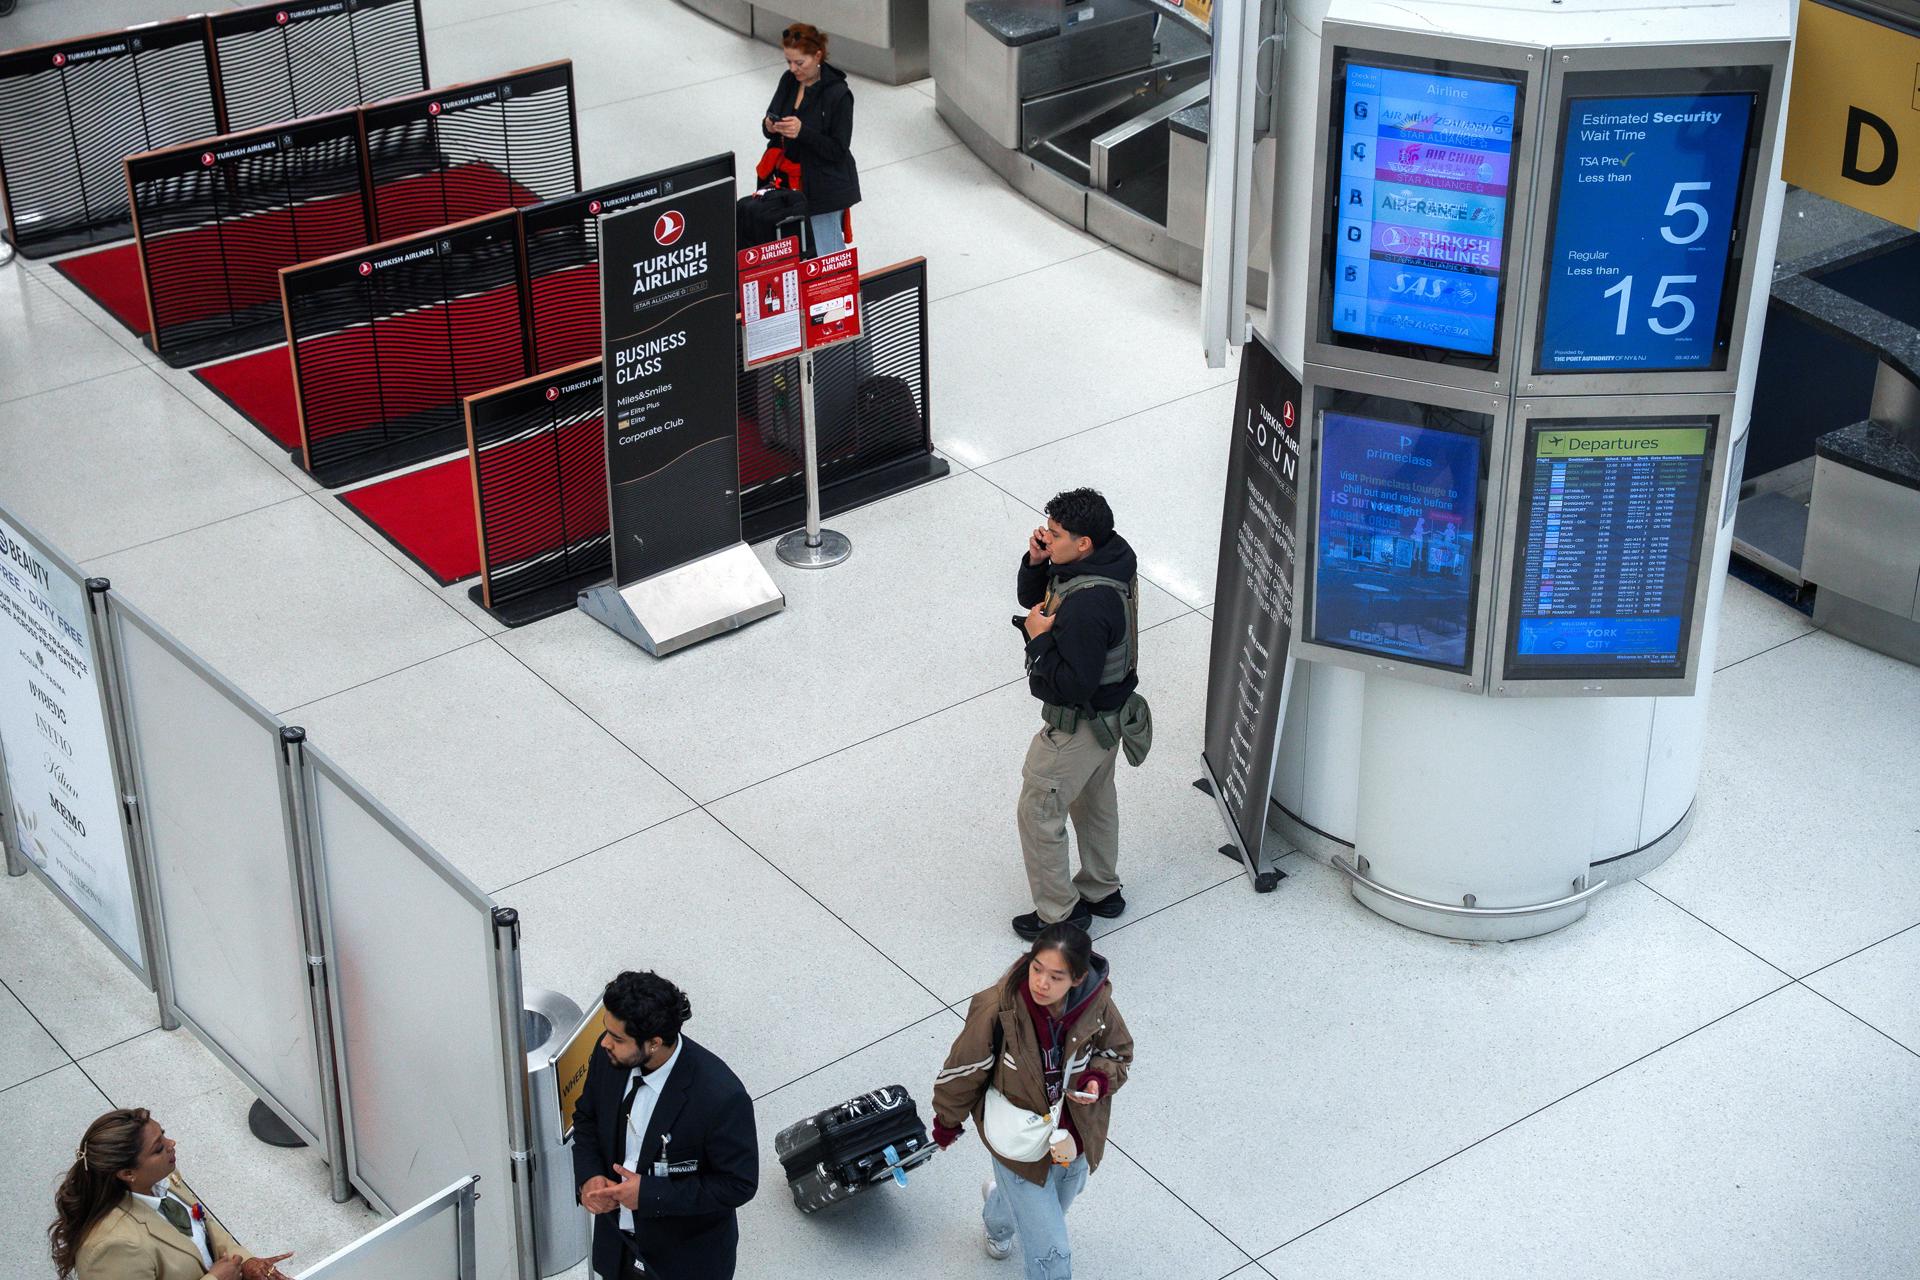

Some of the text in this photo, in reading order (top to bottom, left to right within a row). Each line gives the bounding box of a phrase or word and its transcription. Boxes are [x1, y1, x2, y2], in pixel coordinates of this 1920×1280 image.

[290, 2, 343, 19] TURKISH AIRLINES
[67, 44, 126, 61] TURKISH AIRLINES
[442, 91, 497, 110] TURKISH AIRLINES
[1427, 84, 1469, 98] Airline
[1582, 110, 1722, 126] Estimated Security
[1400, 131, 1477, 148] STAR ALLIANCE
[1581, 129, 1646, 142] Wait Time
[1841, 105, 1898, 186] D
[216, 141, 276, 162] TURKISH AIRLINES
[1426, 148, 1485, 166] AIR CHINA
[1580, 156, 1619, 166] TSA Pre
[1396, 174, 1421, 184] STAR
[1424, 178, 1473, 192] ALLIANCE
[1578, 172, 1632, 183] Less than
[602, 188, 658, 208] TURKISH AIRLINES
[1660, 182, 1712, 245] 5
[761, 240, 792, 254] TURKISH
[1418, 232, 1490, 252] TURKISH
[374, 246, 434, 270] TURKISH AIRLINES
[633, 242, 708, 278] TURKISH
[761, 246, 792, 260] AIRLINES
[822, 252, 852, 266] TURKISH
[1416, 247, 1489, 265] AIRLINES
[1568, 250, 1610, 262] Regular
[822, 258, 852, 273] AIRLINES
[1568, 266, 1620, 276] Less than
[632, 258, 708, 296] AIRLINES
[1388, 272, 1447, 298] SAS
[635, 300, 650, 310] STAR
[651, 290, 680, 304] ALLIANCE
[1604, 274, 1698, 336] 15
[616, 330, 687, 368] BUSINESS
[616, 357, 662, 385] CLASS
[561, 380, 590, 394] TURKISH
[617, 382, 672, 407] Miles&Smiles
[630, 400, 660, 416] Elite Plus
[630, 414, 646, 425] Elite
[1260, 403, 1286, 440] TURKISH
[618, 416, 684, 446] Corporate Club
[1568, 438, 1659, 452] Departures
[1366, 448, 1433, 468] primeclass
[1340, 470, 1457, 498] Visit Primeclass Lounge to
[1344, 484, 1452, 510] chill out and relax before
[1329, 508, 1366, 522] MOBILE
[1368, 514, 1400, 528] ORDER
[8, 538, 50, 591] BEAUTY
[0, 564, 84, 648] REE DUTY FREE
[12, 600, 88, 675] NEW NICHE FRAGRANCE
[1586, 629, 1617, 638] YORK
[13, 613, 76, 675] ACROSS FROM GATE
[1586, 640, 1610, 648] CITY
[44, 751, 79, 798] Kilian
[49, 791, 86, 837] MEMO
